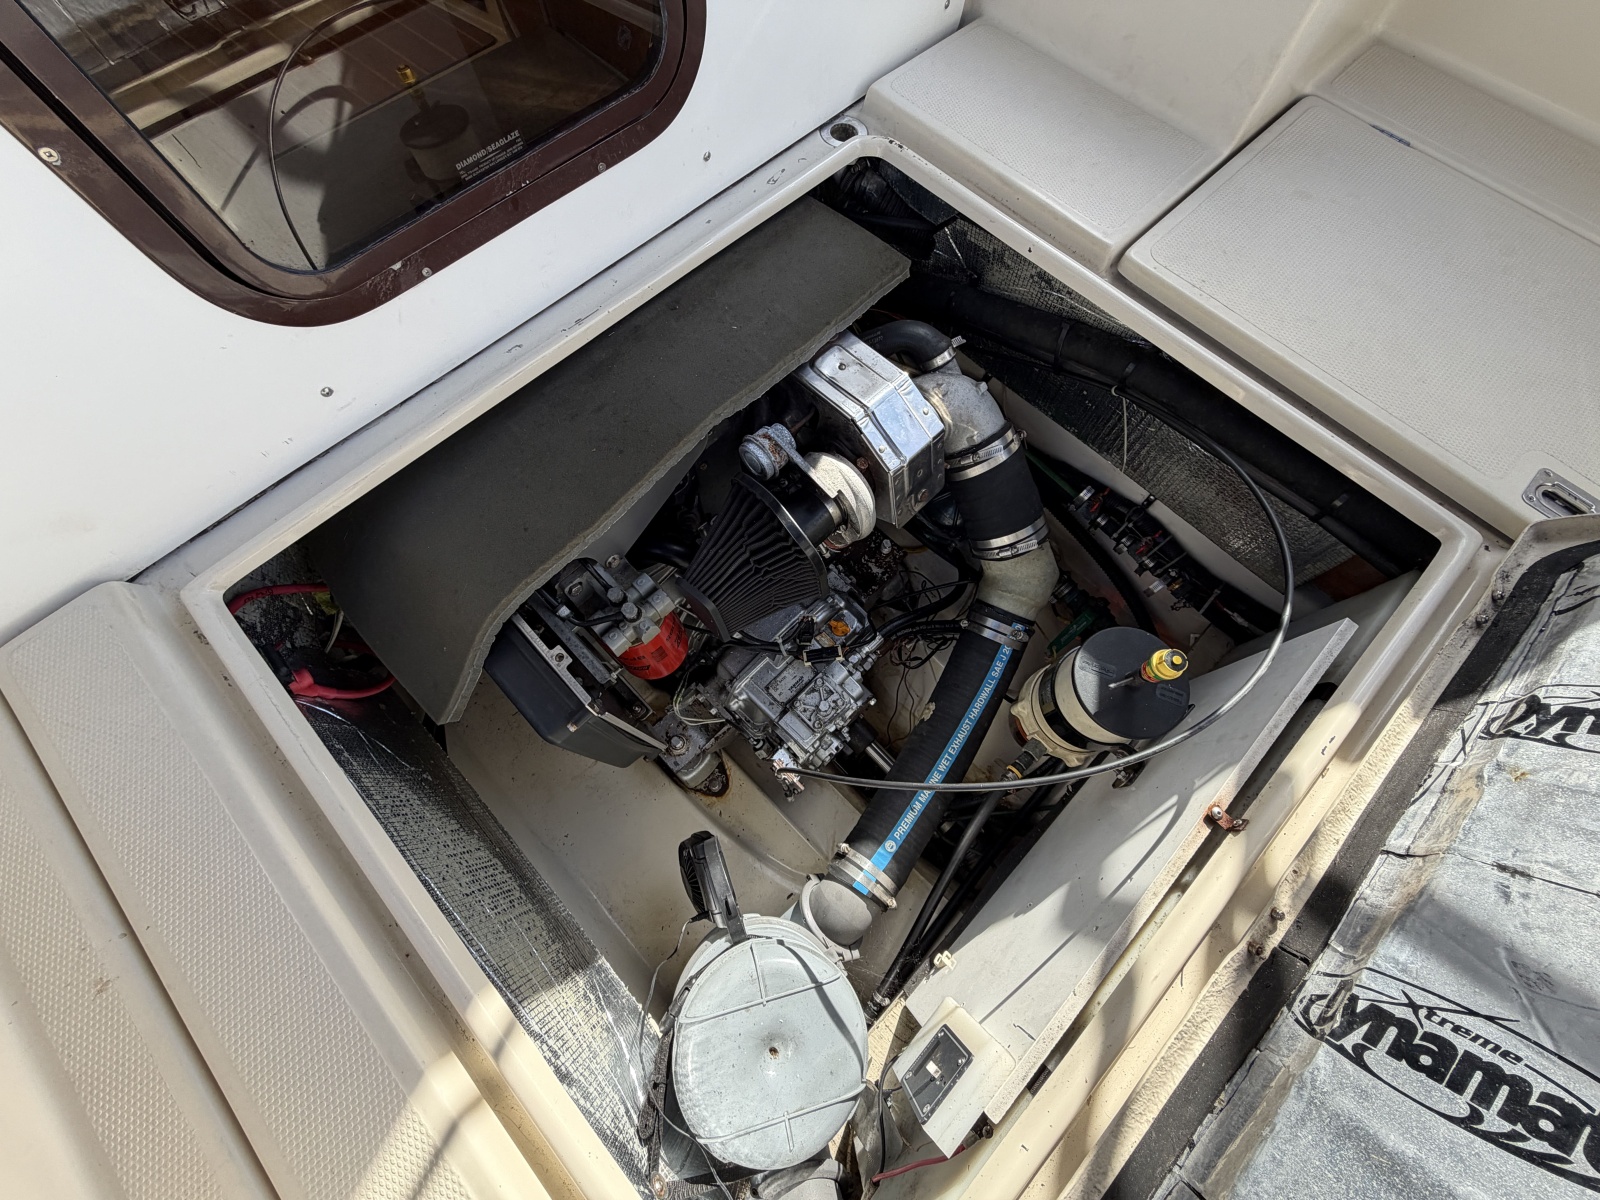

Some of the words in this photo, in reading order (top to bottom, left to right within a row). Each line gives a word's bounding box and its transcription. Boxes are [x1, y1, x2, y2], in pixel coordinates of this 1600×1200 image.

[893, 801, 923, 840] PREMIUM
[937, 753, 952, 772] WET
[948, 719, 973, 755] EXHAUST
[968, 679, 996, 720] HARDWALL
[991, 660, 1005, 678] SAE
[999, 653, 1007, 661] J
